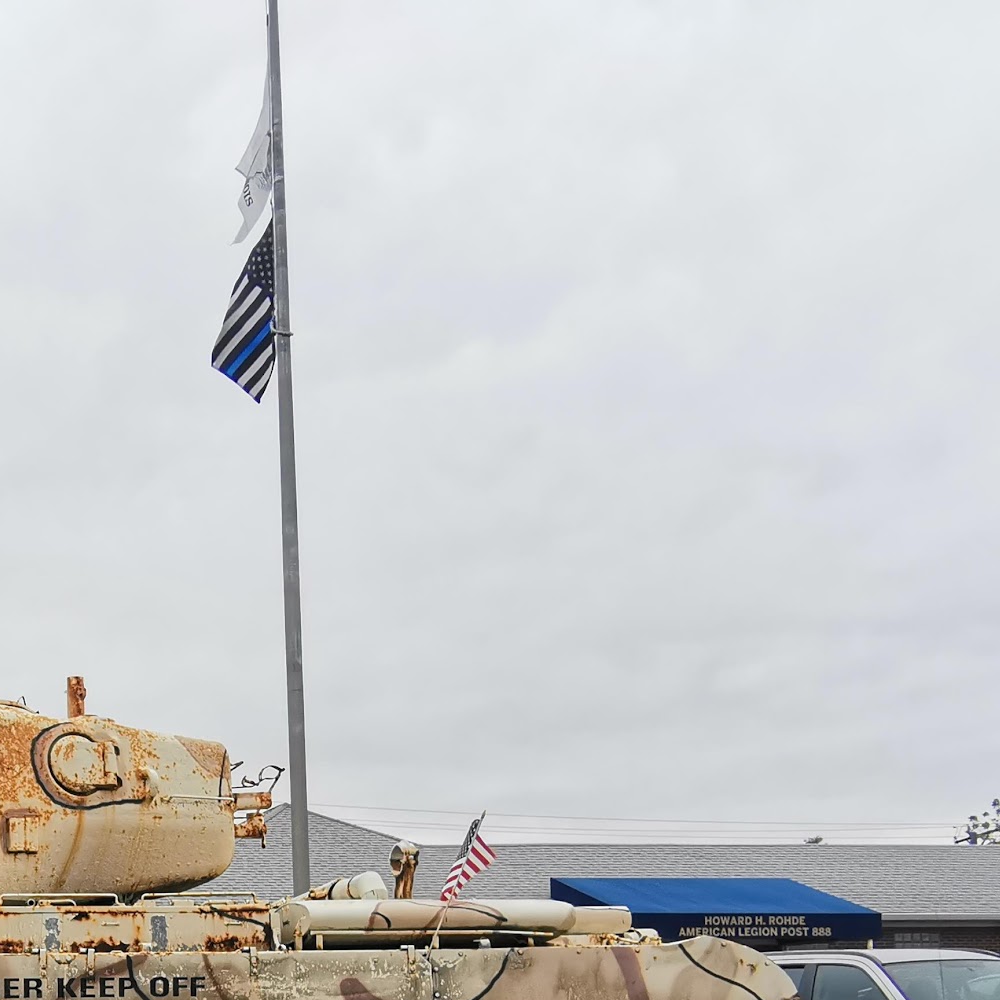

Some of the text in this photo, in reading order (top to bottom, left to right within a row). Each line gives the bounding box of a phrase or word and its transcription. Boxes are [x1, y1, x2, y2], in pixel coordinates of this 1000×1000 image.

[704, 916, 806, 925] HOWARD H. ROHDE
[679, 927, 832, 937] AMERICAN LEGION POST 888
[58, 976, 133, 999] KEEP
[149, 976, 205, 997] OFF
